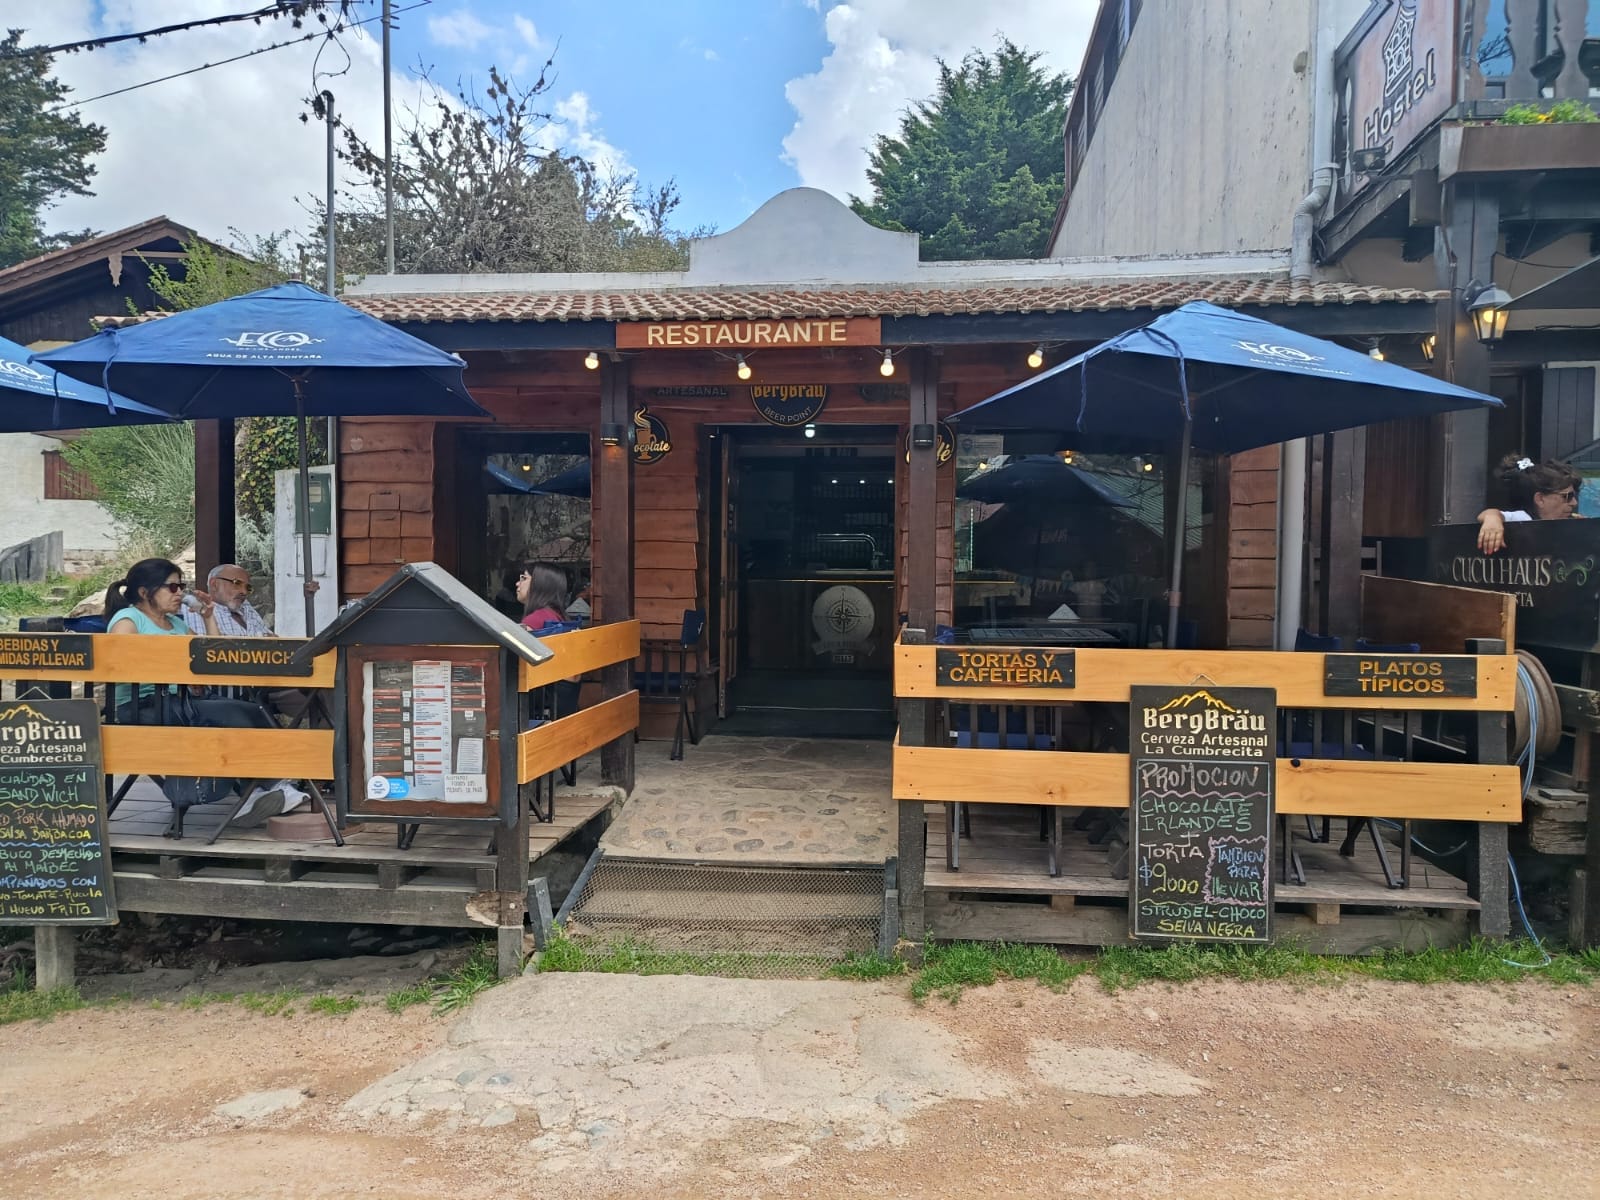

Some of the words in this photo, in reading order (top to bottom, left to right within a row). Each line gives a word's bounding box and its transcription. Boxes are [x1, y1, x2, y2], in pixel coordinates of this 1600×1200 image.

[1363, 48, 1435, 150] Hostel
[647, 321, 847, 345] RESTAURANTE
[764, 407, 785, 422] BEER
[787, 406, 812, 422] POINT
[1452, 557, 1496, 584] CUCU
[1499, 557, 1551, 587] HAUS
[51, 639, 60, 652] Y
[958, 653, 1037, 668] TORTAS
[1041, 654, 1055, 668] Y
[1360, 661, 1443, 676] PLATOS
[950, 667, 1063, 683] CAFETERIA
[1357, 676, 1445, 693] TÍPICOS
[1143, 707, 1266, 734] BergBräu
[1141, 732, 1195, 745] Cerveza
[1202, 733, 1268, 747] Artesanal
[26, 742, 87, 754] Artesanal
[1145, 745, 1164, 755] La
[1171, 745, 1263, 757] Cumbrecita
[0, 753, 83, 764] Cumbrecita
[64, 771, 86, 783] EN
[1139, 762, 1259, 792] PROMOCION
[1140, 797, 1254, 818] CHOCOLATE
[13, 808, 49, 827] PORK
[1140, 814, 1252, 835] IRLANDES
[30, 826, 91, 844] BARBACOA
[1140, 843, 1204, 863] TORTA
[1215, 845, 1264, 864] TAMBIEN
[1227, 864, 1260, 879] PARA
[72, 875, 97, 887] CON
[9, 903, 45, 915] HUEVO
